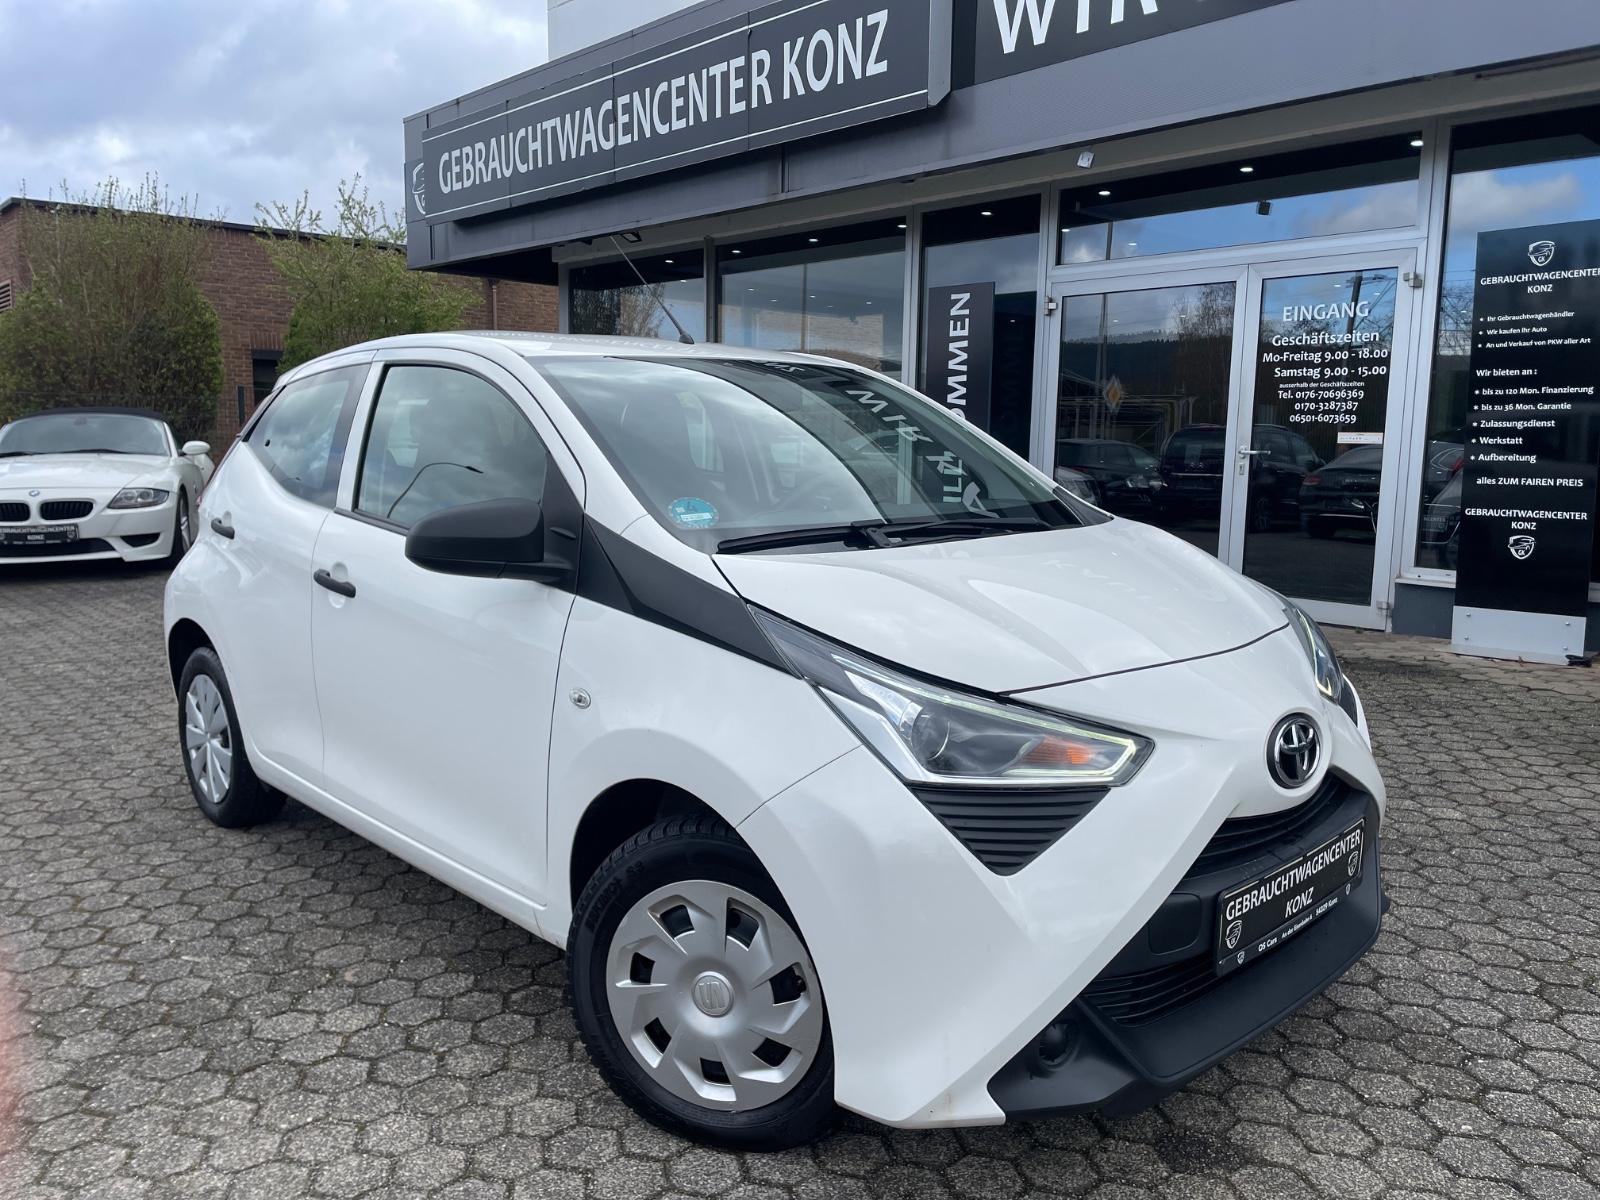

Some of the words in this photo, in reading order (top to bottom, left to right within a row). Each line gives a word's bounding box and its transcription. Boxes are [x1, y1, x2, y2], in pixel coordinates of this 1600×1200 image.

[438, 49, 773, 194] GEBRAUCHTWAGENCENTER
[782, 9, 889, 100] KONZ
[1527, 284, 1553, 293] KONZ
[1283, 301, 1370, 322] EINGANG
[1497, 311, 1575, 322] Gebrauchtwagenhändler
[1499, 327, 1521, 335] kaufen
[1272, 330, 1380, 347] Geschäftszeiten
[1262, 351, 1322, 363] Mo-Freitag
[1324, 351, 1349, 360] 9.00
[1358, 348, 1388, 359] 18.00
[1274, 367, 1321, 379] Samstag
[1324, 367, 1348, 377] 9.00
[1358, 366, 1387, 376] 15.00
[1476, 369, 1492, 377] Wir
[1493, 368, 1520, 377] bieten
[1278, 390, 1294, 399] Tel.
[1295, 390, 1365, 399] 0176-70696369
[1519, 387, 1540, 395] Mon.
[1541, 386, 1594, 395] Finanzierung
[1294, 402, 1359, 411] 0170-3287387
[1537, 402, 1572, 410] Garantie
[1289, 414, 1357, 424] 06501-6073659
[1480, 420, 1556, 430] Zulassungsdienst
[1479, 437, 1523, 445] Werkstatt
[1478, 454, 1537, 464] Aufbereitung
[1476, 477, 1496, 485] alles
[1498, 478, 1519, 486] ZUM
[1521, 478, 1554, 487] FAIREN
[1556, 479, 1584, 487] PREIS
[1465, 508, 1588, 520] GEBRAUCHTWAGENCENTER
[1511, 521, 1537, 530] KONZ
[1226, 829, 1361, 921] GEBRAUCHTWAGENCENTER
[1285, 886, 1314, 918] KONZ
